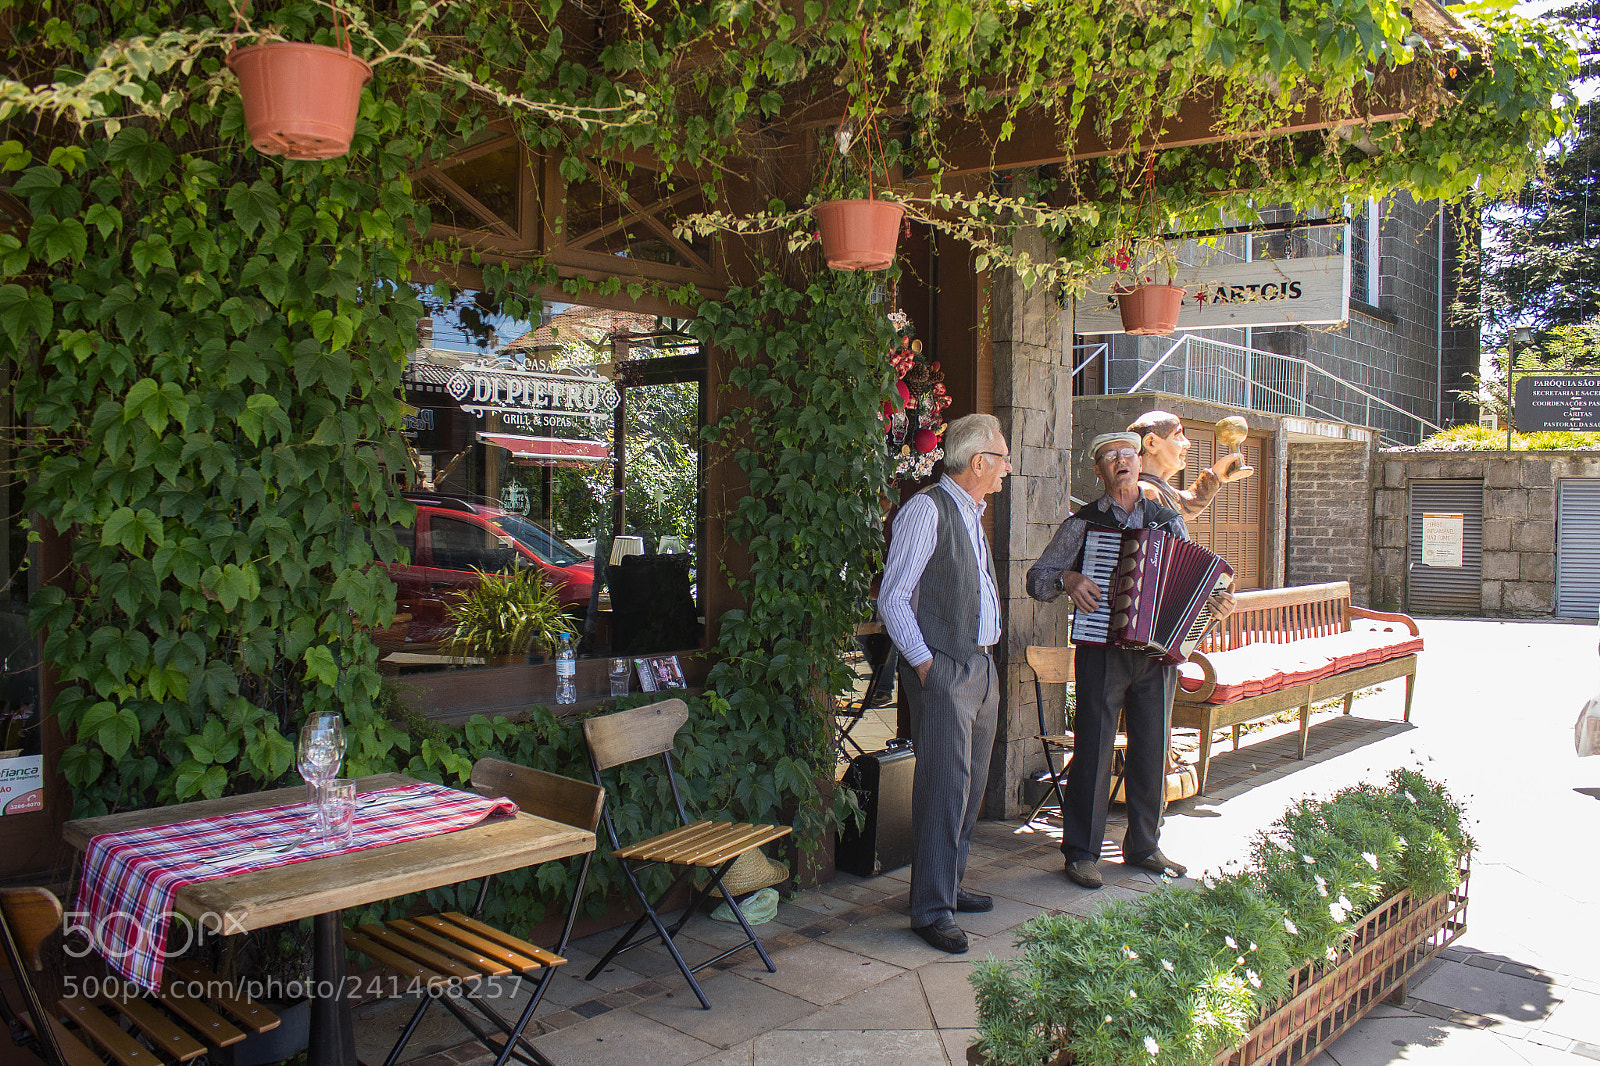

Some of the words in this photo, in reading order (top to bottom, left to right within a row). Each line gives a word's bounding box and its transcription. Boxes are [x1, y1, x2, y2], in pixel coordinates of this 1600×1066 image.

[1213, 281, 1303, 304] ARTOIS
[523, 358, 552, 371] CASA
[1534, 379, 1576, 387] PARÓQUIA
[1578, 379, 1595, 387] SÃO
[472, 378, 500, 402] DI
[505, 379, 601, 410] PIETRO
[503, 413, 530, 425] GRILL
[534, 416, 541, 425] &
[543, 416, 572, 427] SOPAS
